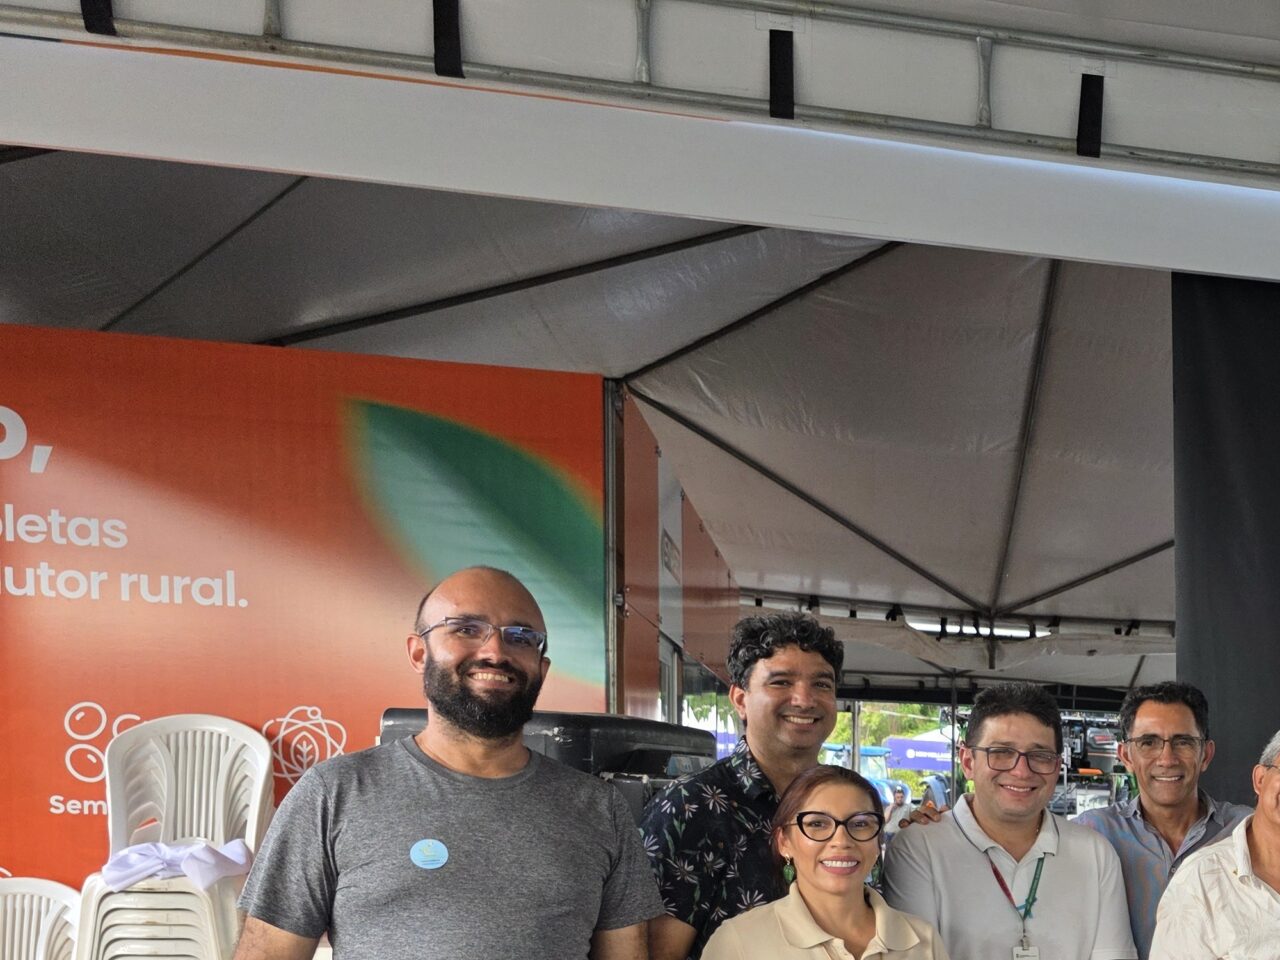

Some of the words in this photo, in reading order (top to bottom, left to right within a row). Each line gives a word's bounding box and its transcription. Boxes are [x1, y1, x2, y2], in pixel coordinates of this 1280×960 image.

[0, 503, 129, 549] letas
[0, 561, 109, 601] utor
[120, 569, 249, 609] rural.
